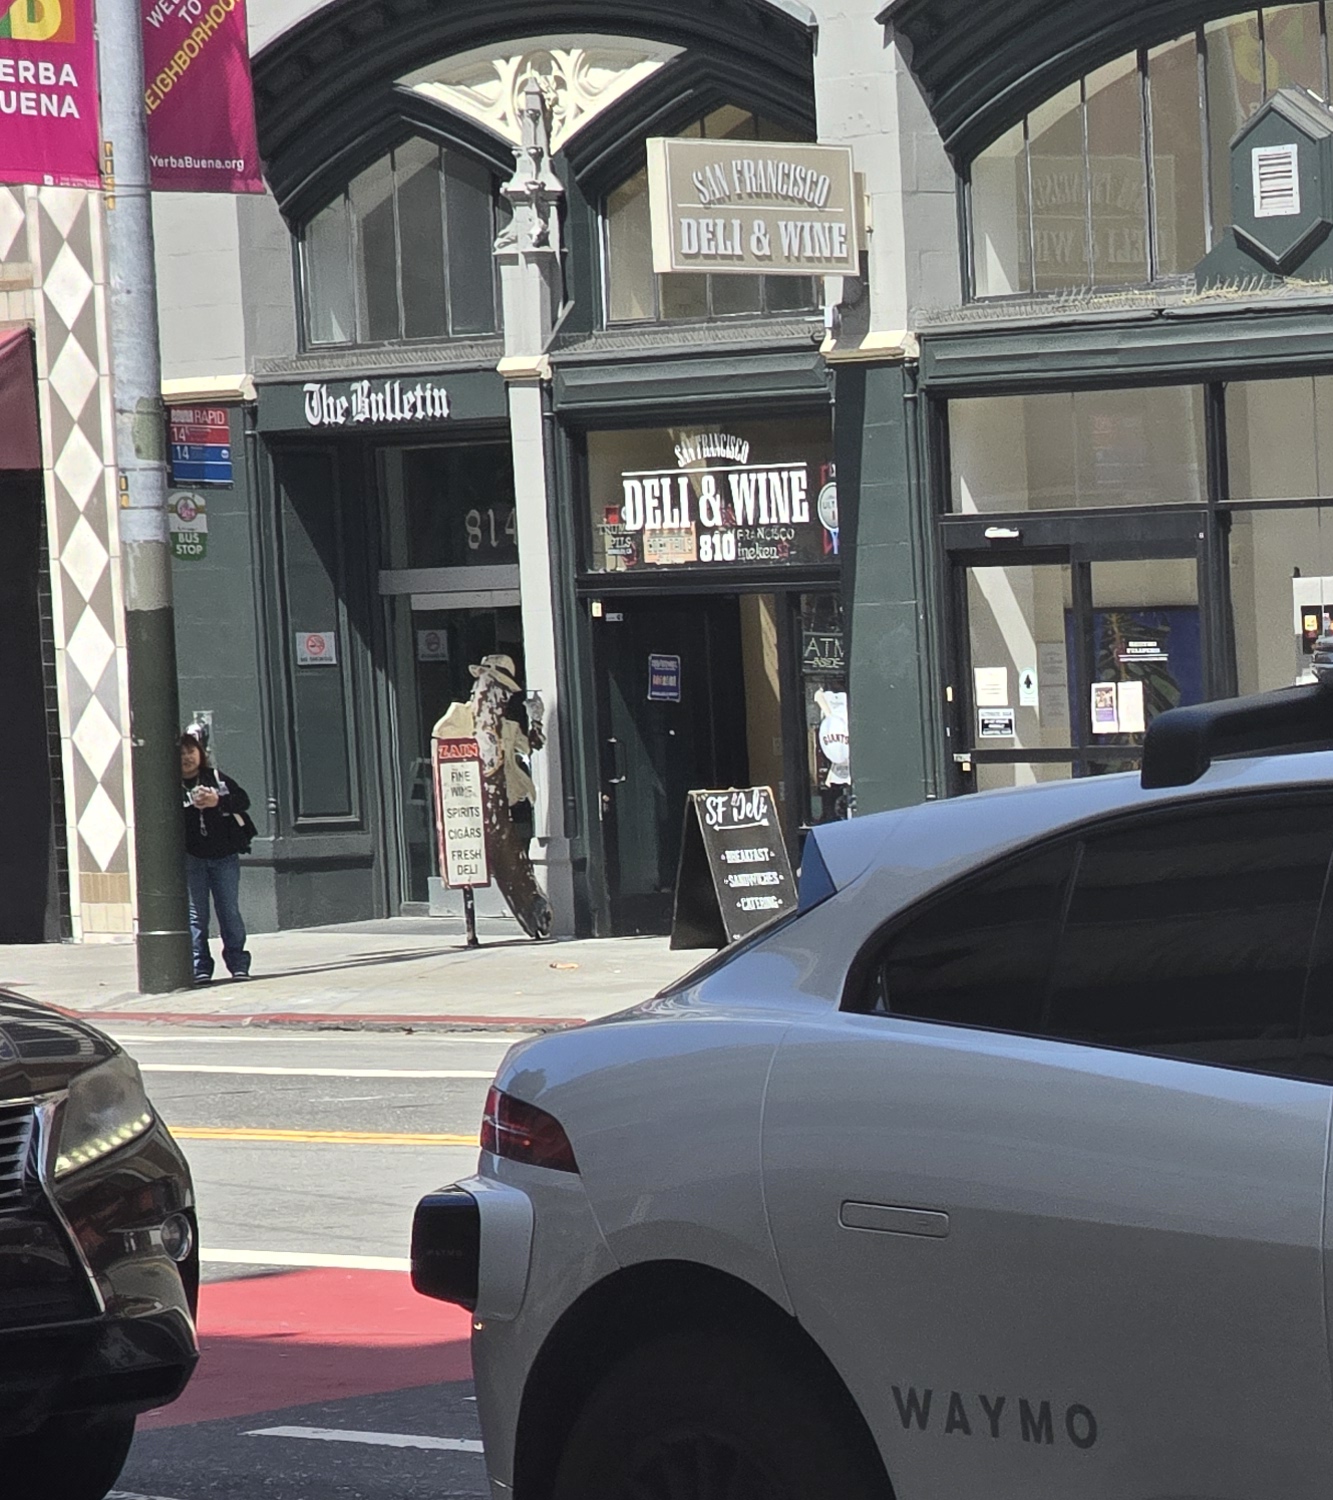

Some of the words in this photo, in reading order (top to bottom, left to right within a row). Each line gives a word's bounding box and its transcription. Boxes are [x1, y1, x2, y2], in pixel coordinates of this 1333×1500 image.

[178, 0, 202, 24] TO
[144, 0, 241, 116] EIGHBORHOO
[150, 156, 244, 171] YerbaBuena.org
[692, 162, 730, 204] SAN
[731, 159, 830, 207] FRANCISCO
[680, 217, 743, 256] DELI
[751, 219, 771, 256] &
[777, 220, 848, 258] WINE
[303, 383, 349, 426] The
[350, 379, 450, 423] Bulletin
[194, 409, 225, 425] RAPID
[176, 445, 189, 460] 14
[674, 436, 693, 467] SAN
[694, 432, 749, 464] FRANCISCO
[623, 476, 691, 531] DELI
[699, 474, 722, 528] &
[728, 470, 810, 526] WINE
[178, 533, 200, 544] BUS
[175, 544, 203, 555] STOP
[699, 533, 736, 562] 810
[823, 733, 849, 746] GIANTS
[439, 743, 478, 759] ZAIN
[451, 770, 471, 783] FINE
[446, 806, 480, 819] SPIRITS
[705, 796, 729, 825] SF
[731, 788, 768, 822] Deli
[448, 827, 482, 840] CIGARS
[451, 849, 482, 861] FRESH
[457, 864, 478, 876] DELI
[891, 1384, 1097, 1450] WAYMO
